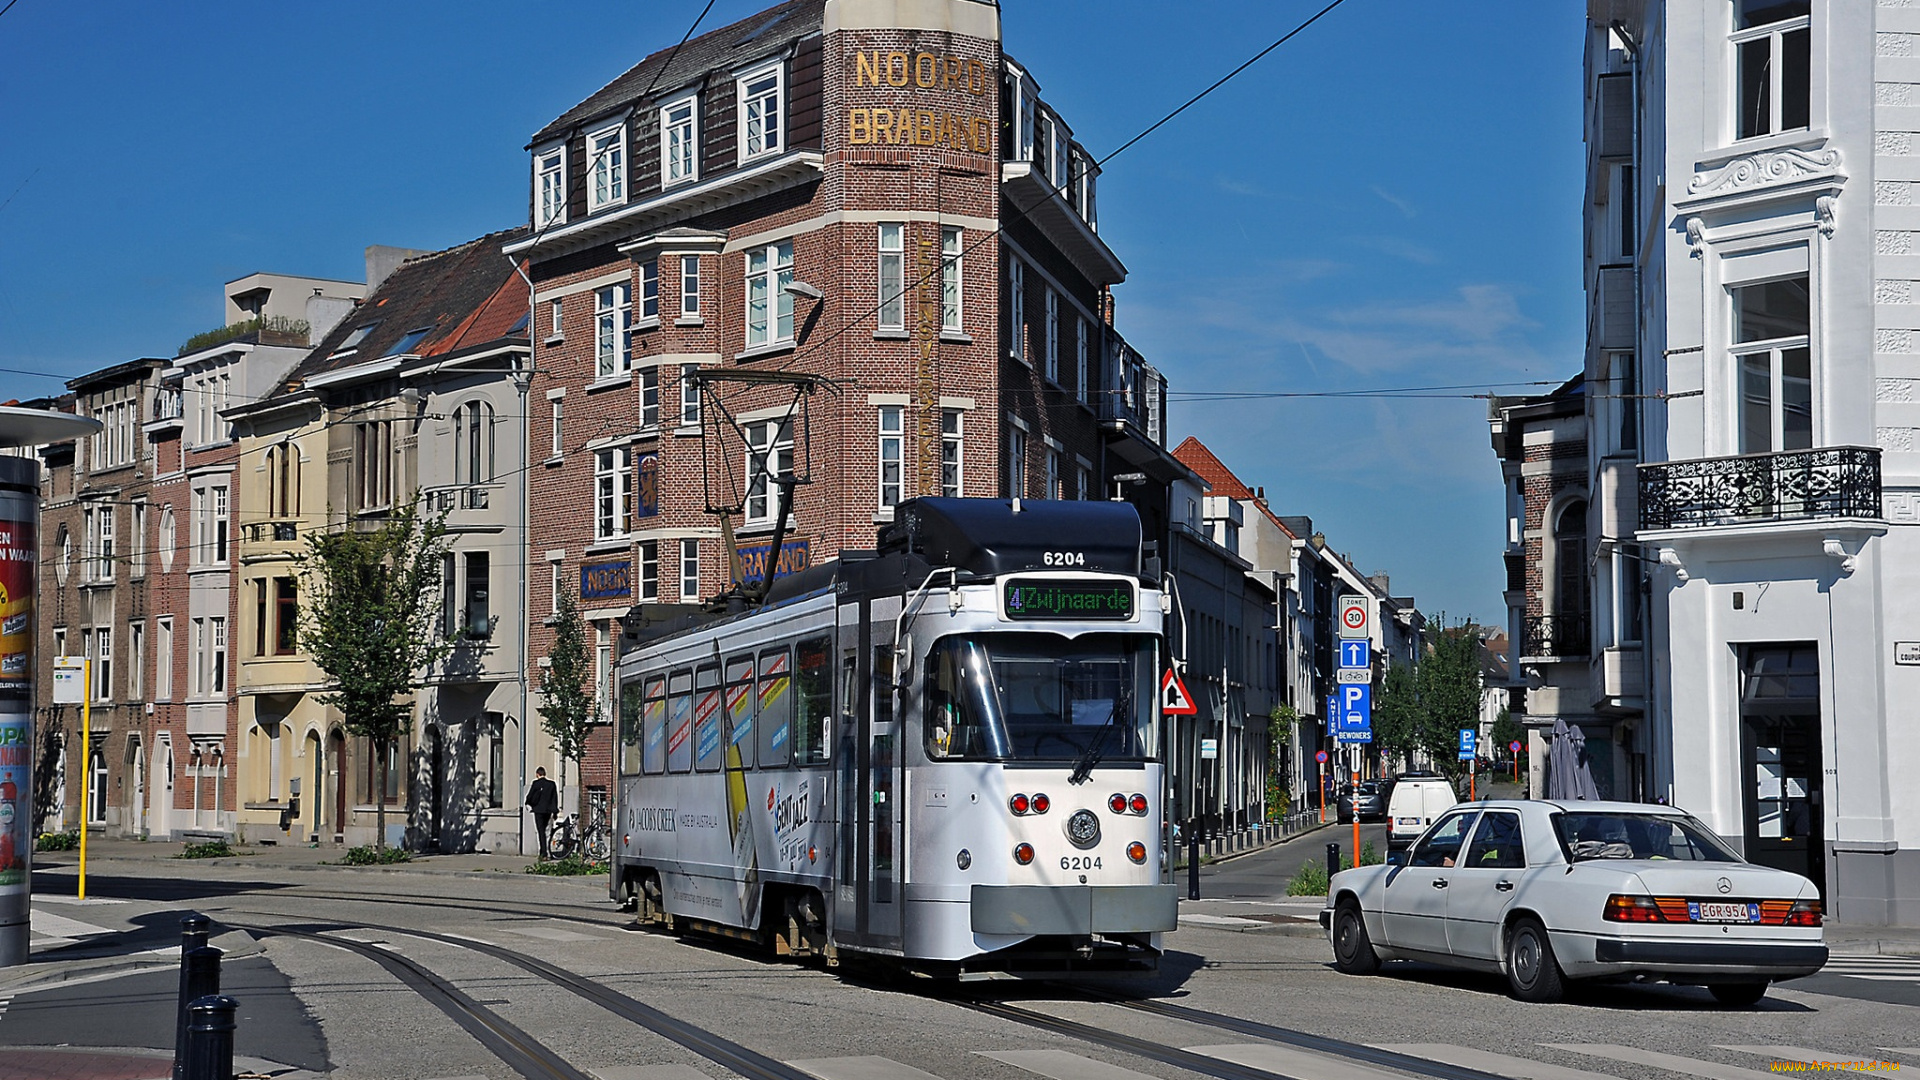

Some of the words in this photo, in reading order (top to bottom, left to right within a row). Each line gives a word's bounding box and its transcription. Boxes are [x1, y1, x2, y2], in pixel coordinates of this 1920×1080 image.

[857, 51, 985, 96] NOORD
[850, 108, 990, 154] BRABAND
[0, 532, 10, 544] N
[1043, 552, 1085, 566] 6204
[1010, 588, 1022, 610] 4
[1026, 587, 1129, 613] Zwijnaarde
[1348, 614, 1361, 622] 30
[1346, 687, 1362, 710] P
[1338, 732, 1371, 740] BEWONERS
[1463, 731, 1472, 743] P
[657, 808, 677, 832] CREEK
[777, 794, 793, 832] GENT
[792, 792, 808, 832] JAZZ
[1060, 856, 1103, 870] 6204
